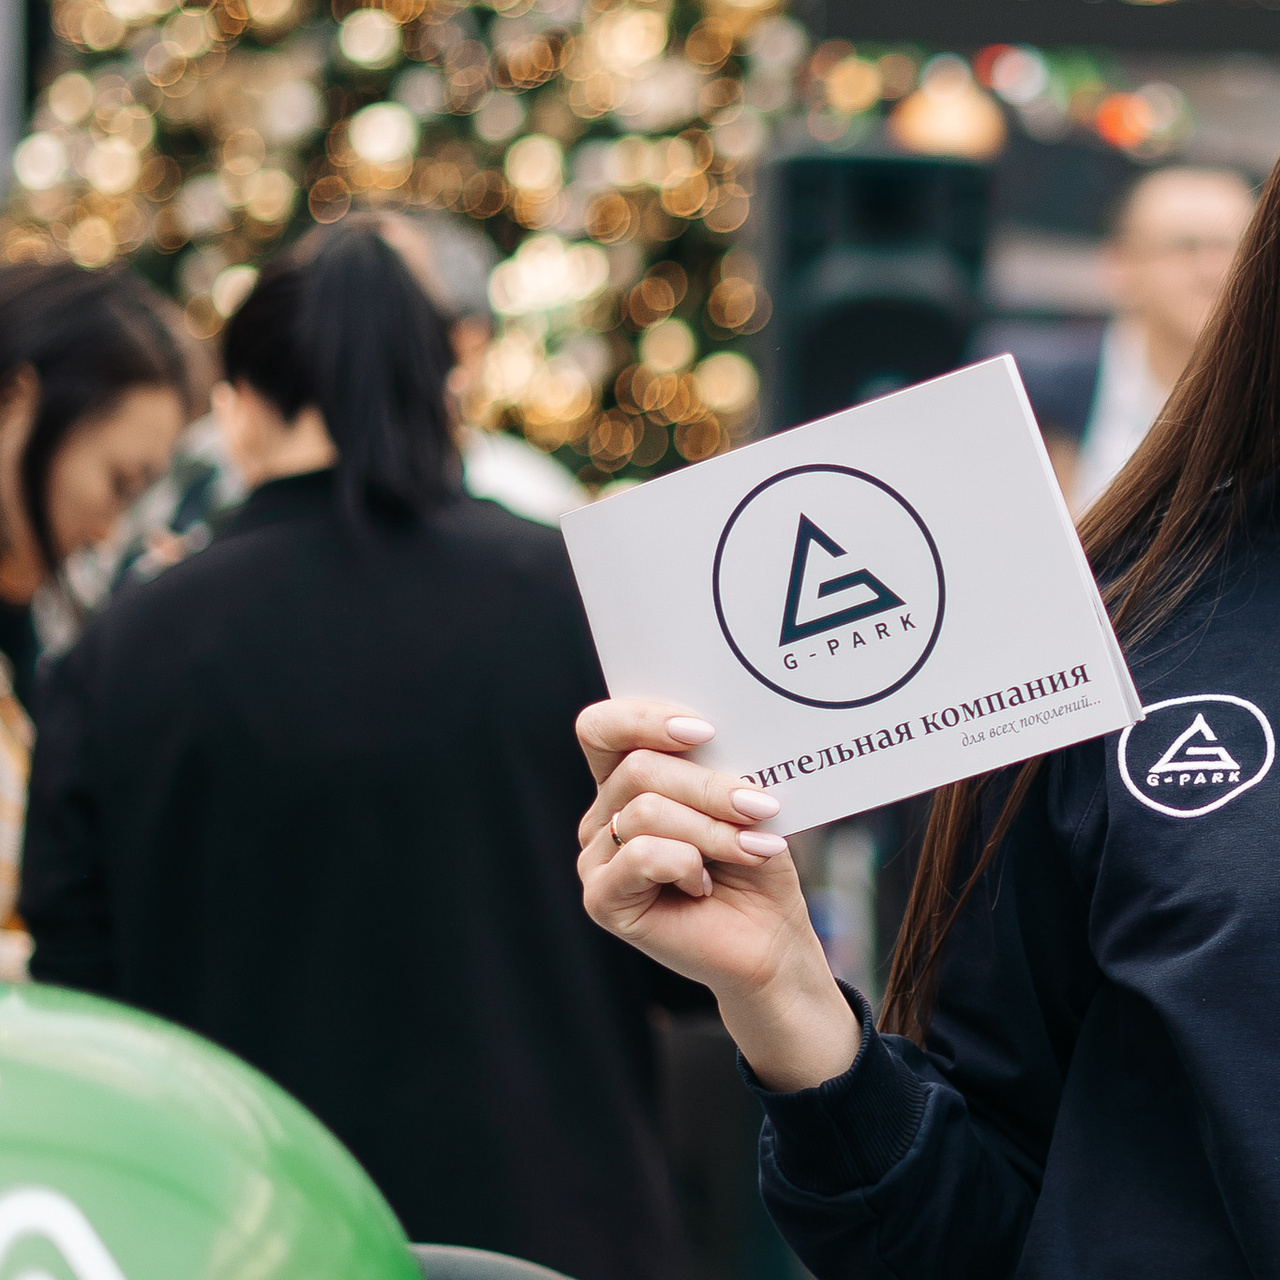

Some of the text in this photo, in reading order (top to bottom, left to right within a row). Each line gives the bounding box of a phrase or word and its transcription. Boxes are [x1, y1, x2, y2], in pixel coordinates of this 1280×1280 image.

[783, 613, 917, 671] G-PARK
[739, 663, 1092, 789] ительная компания
[961, 732, 986, 747] для
[989, 719, 1020, 737] всех
[1146, 771, 1241, 787] G-PARK
